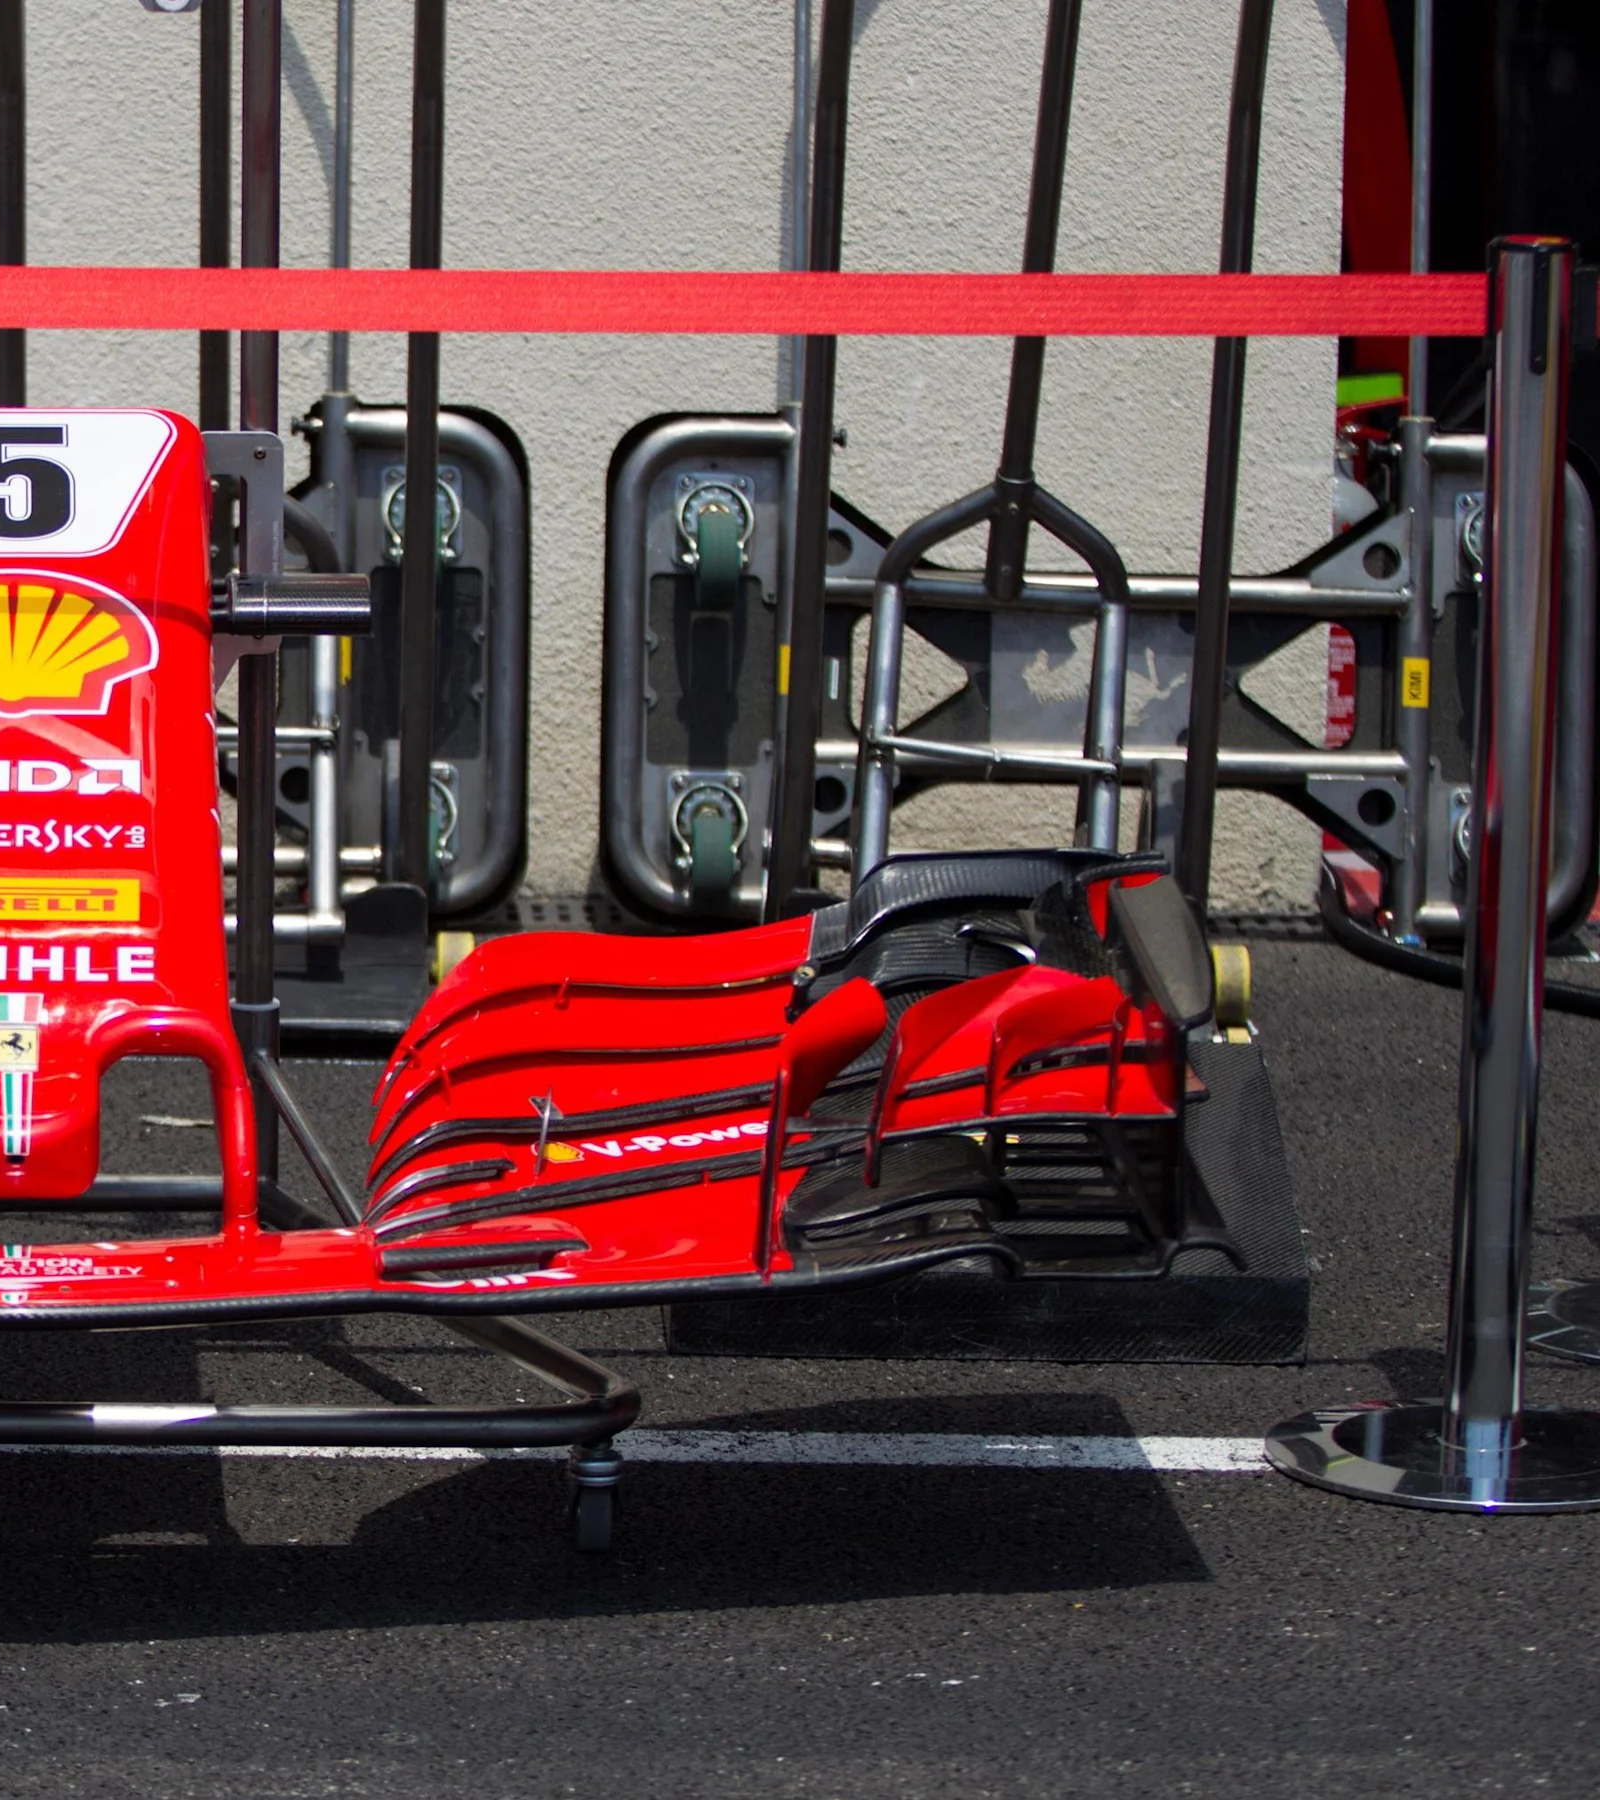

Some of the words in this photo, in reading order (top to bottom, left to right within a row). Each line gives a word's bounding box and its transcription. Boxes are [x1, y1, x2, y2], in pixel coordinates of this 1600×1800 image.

[1409, 671, 1422, 700] KIMI
[124, 825, 146, 848] lab
[581, 1120, 770, 1157] V-Powe
[44, 1265, 143, 1276] SAFETY
